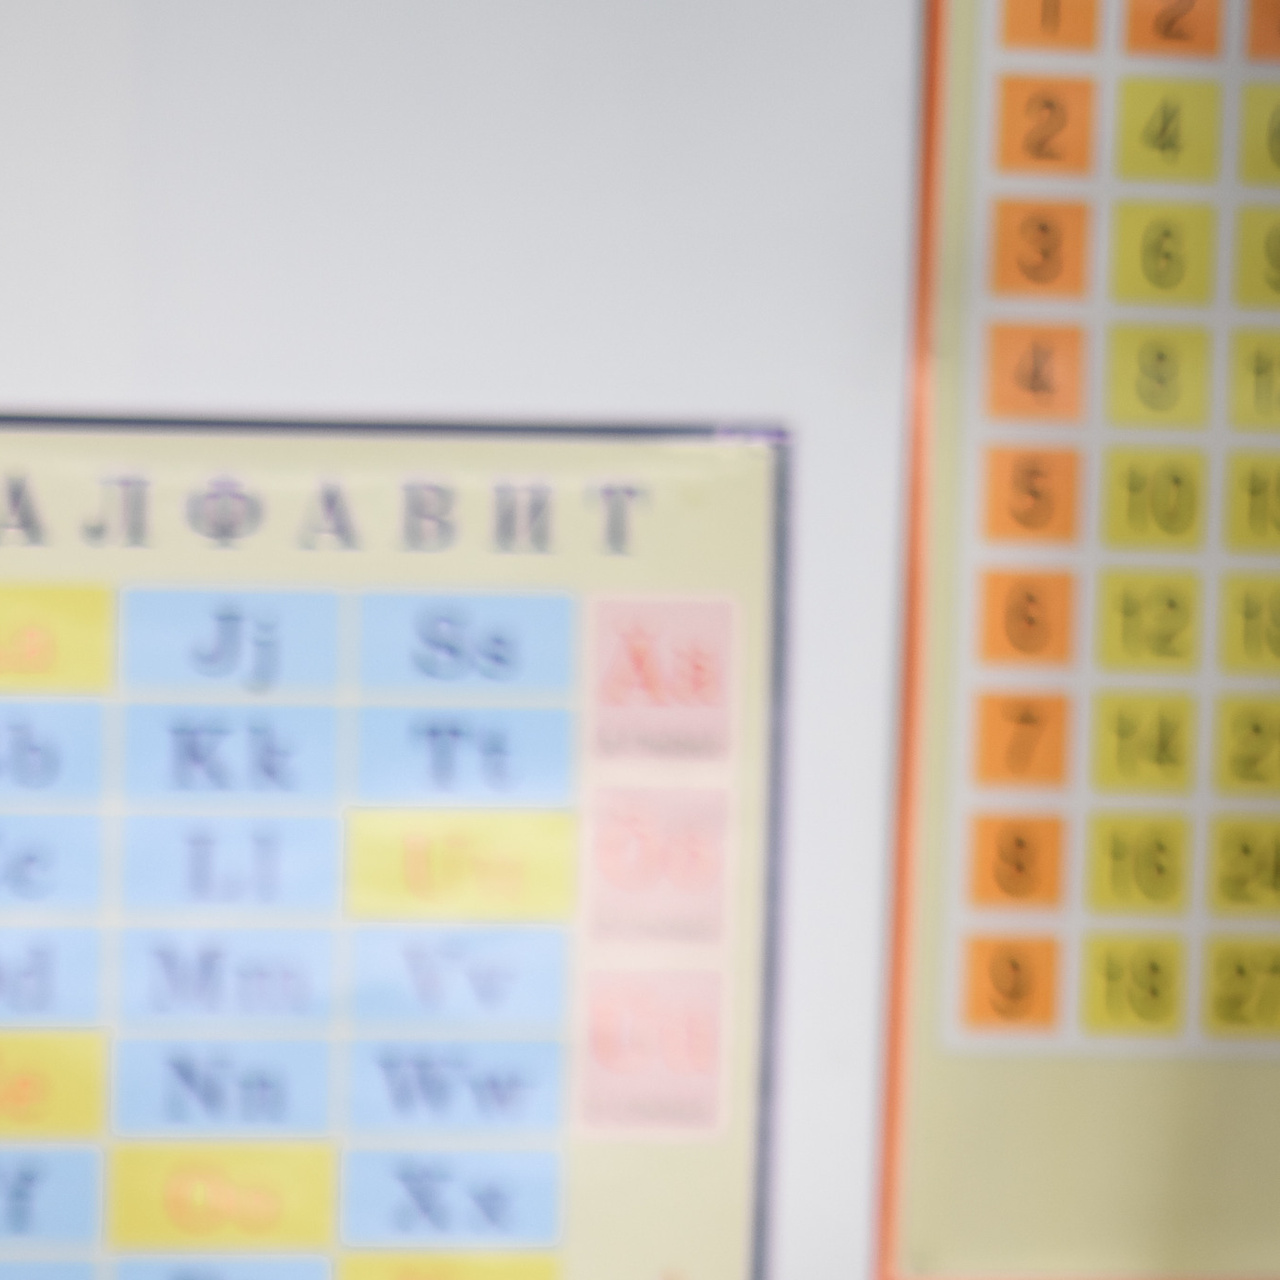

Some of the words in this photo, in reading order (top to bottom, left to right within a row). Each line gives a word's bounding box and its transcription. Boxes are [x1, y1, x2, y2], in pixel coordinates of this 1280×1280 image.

[1023, 89, 1069, 162] 2
[1141, 97, 1184, 165] 4
[1017, 212, 1064, 285] 3
[1140, 218, 1186, 290] 6
[1014, 340, 1056, 407] 4
[1136, 337, 1181, 413] 8
[1008, 455, 1055, 530] 5
[1126, 462, 1197, 536] 10
[187, 605, 281, 695] Jj
[408, 607, 518, 683] Ss
[1005, 578, 1049, 655] 6
[168, 722, 297, 792] Kk
[410, 722, 511, 792] Tt
[1001, 702, 1046, 777] 7
[993, 819, 1040, 899] 8
[150, 945, 314, 1016] Mm
[988, 940, 1032, 1021] 9
[165, 1054, 289, 1124] Nn
[378, 1052, 532, 1121] Ww
[394, 1165, 512, 1233] Xx
